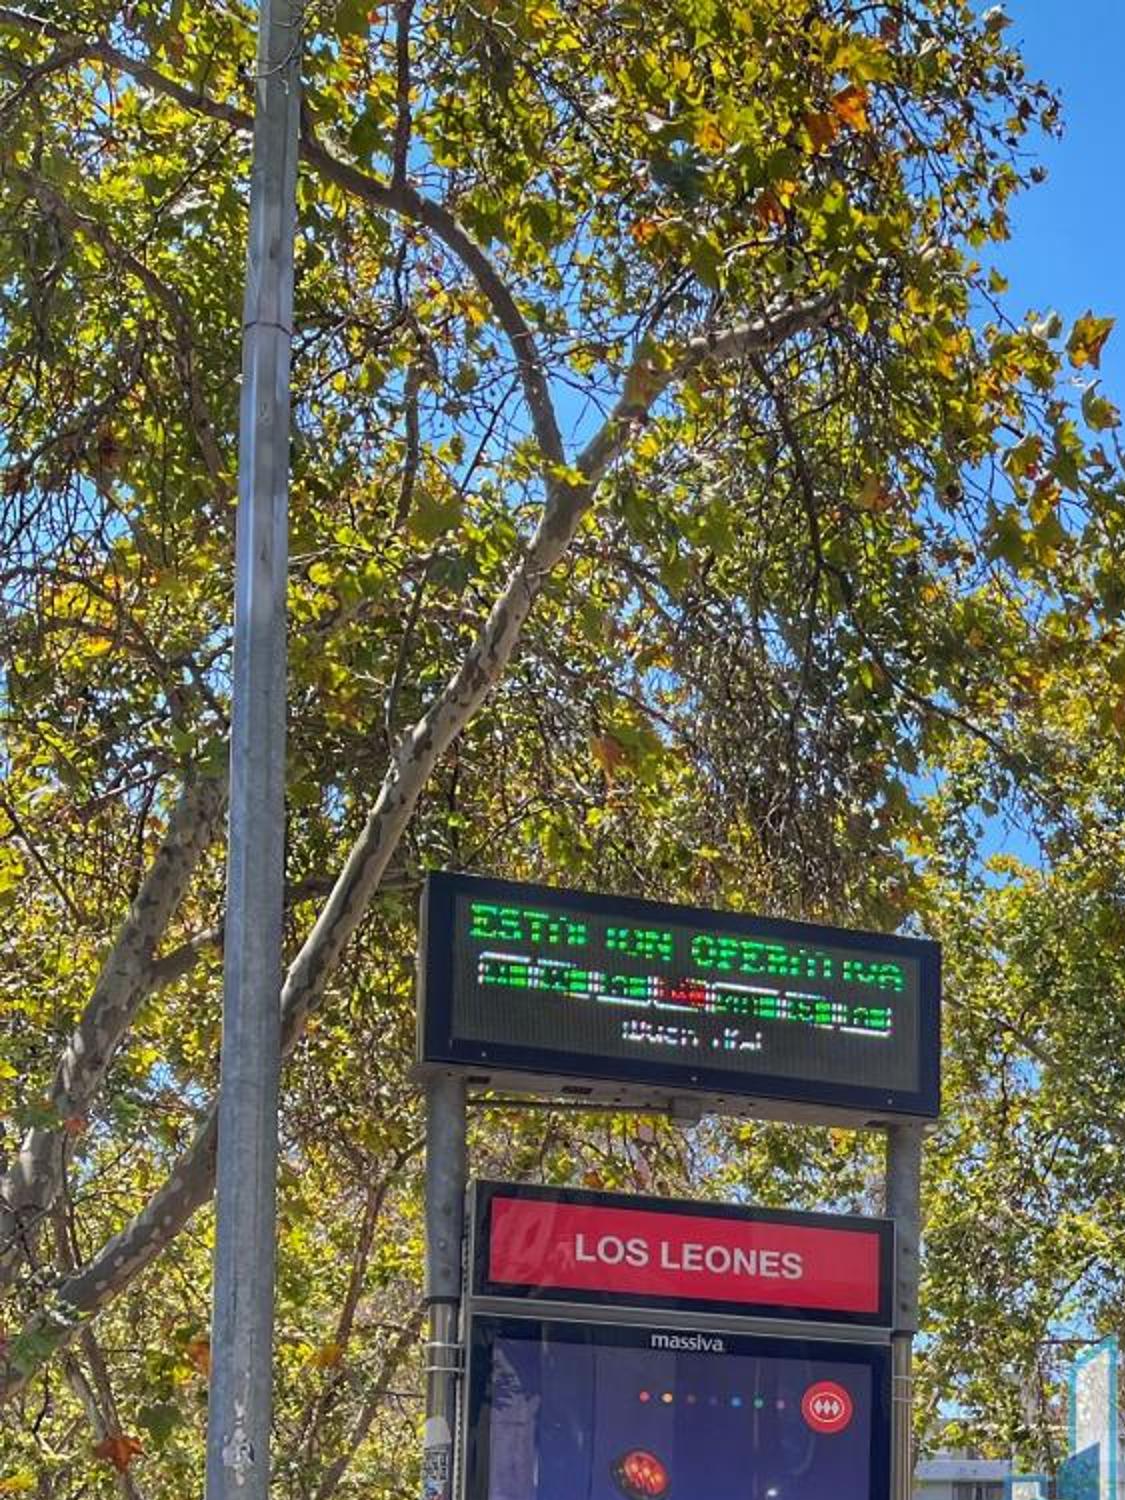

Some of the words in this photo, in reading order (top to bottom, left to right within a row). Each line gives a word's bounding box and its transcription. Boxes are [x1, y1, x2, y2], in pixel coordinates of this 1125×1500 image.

[575, 1233, 649, 1267] LOS
[660, 1241, 803, 1280] LEONES
[650, 1332, 724, 1352] massiva
